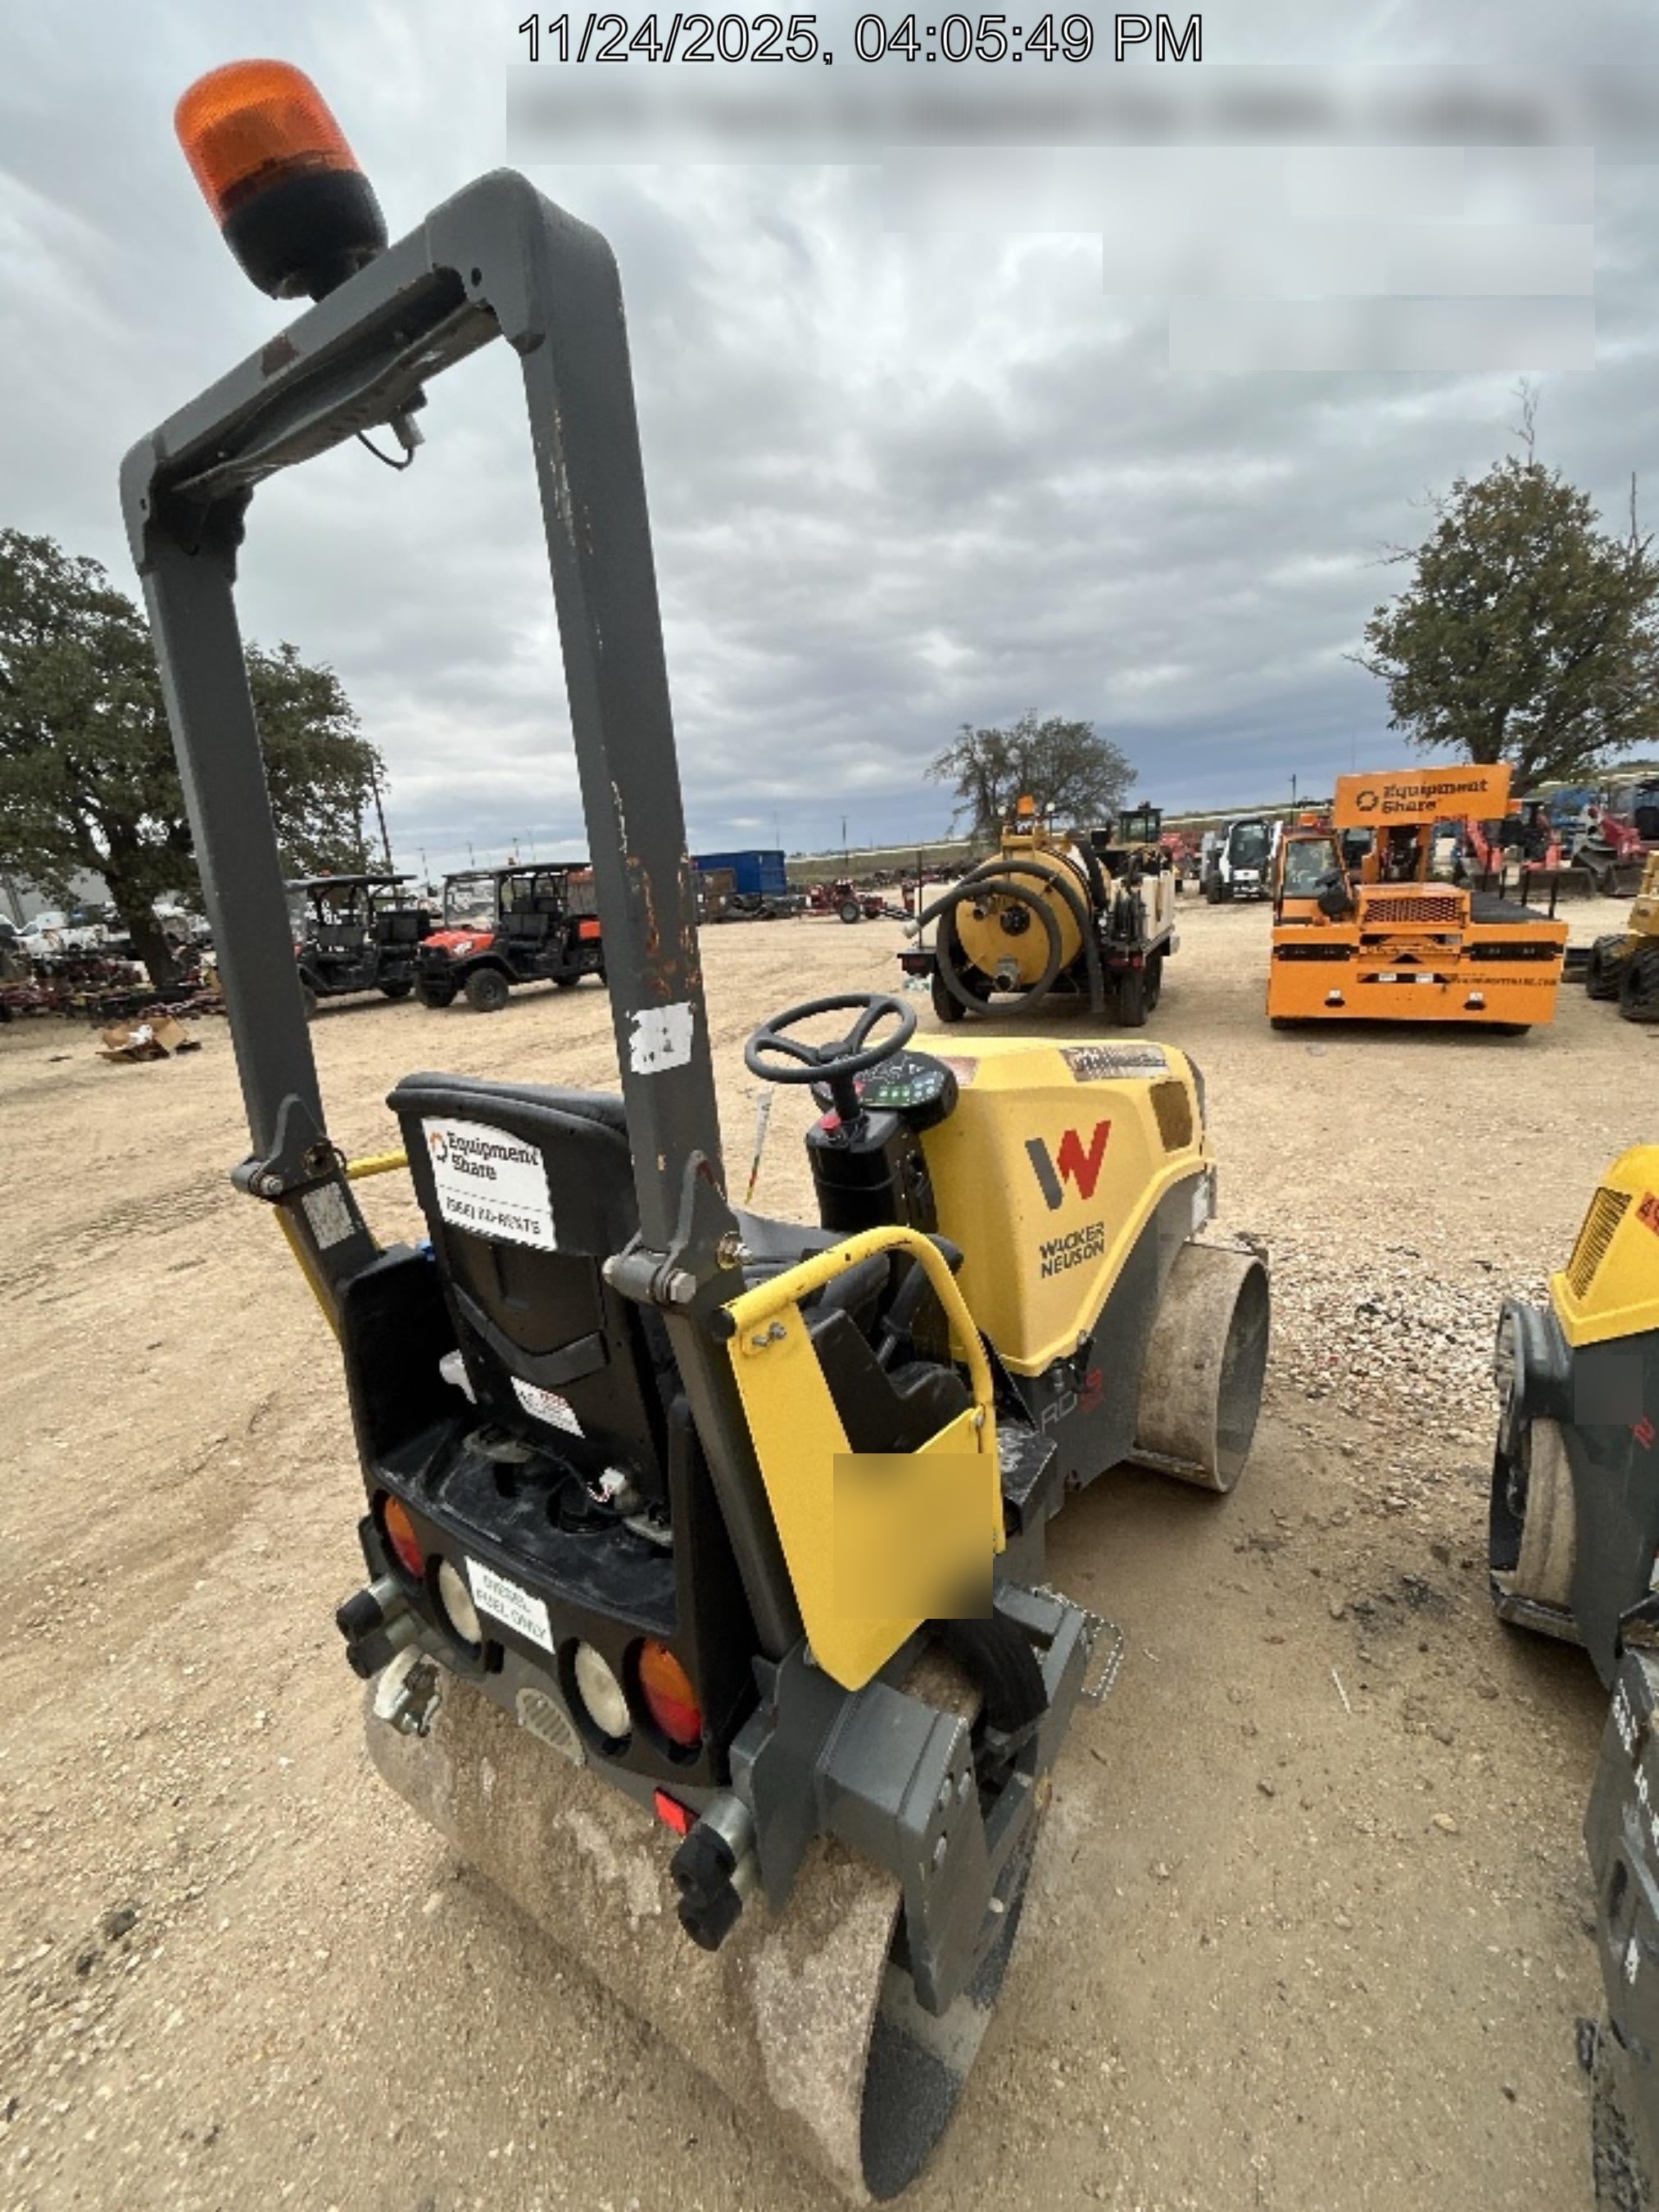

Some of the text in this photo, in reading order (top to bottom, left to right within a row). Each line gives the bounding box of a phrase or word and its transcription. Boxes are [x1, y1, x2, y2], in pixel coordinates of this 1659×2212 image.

[1384, 779, 1489, 799] Equipment
[1381, 800, 1437, 814] Share
[446, 1131, 539, 1166] Equipment
[451, 1152, 497, 1181] Share
[1041, 1238, 1104, 1279] NEUSON
[476, 1588, 510, 1618] FUEL
